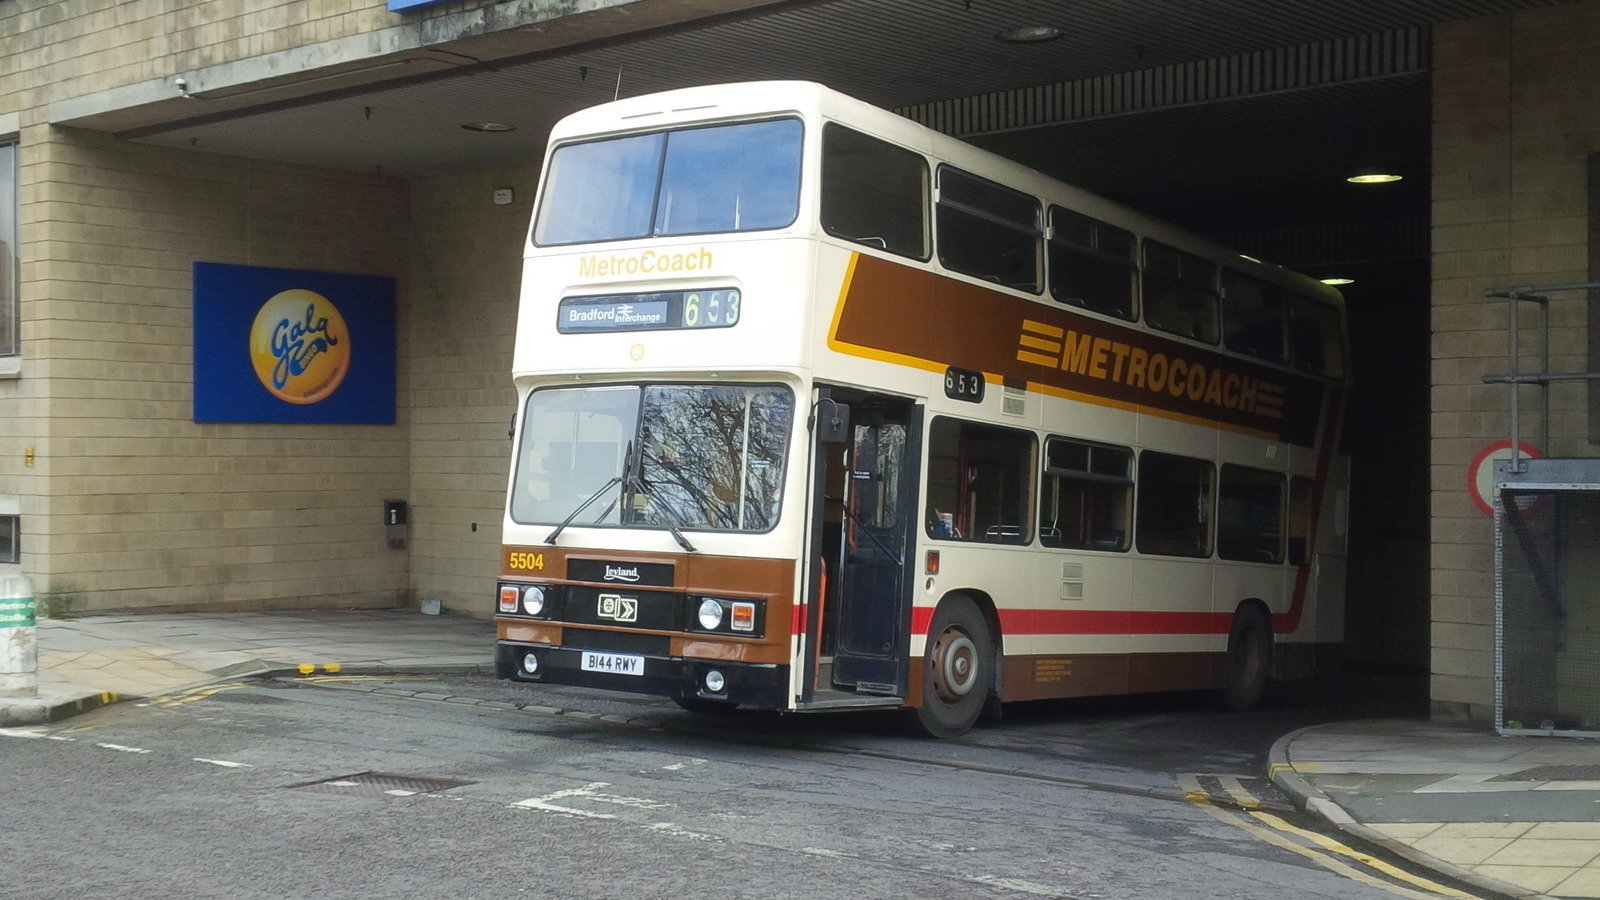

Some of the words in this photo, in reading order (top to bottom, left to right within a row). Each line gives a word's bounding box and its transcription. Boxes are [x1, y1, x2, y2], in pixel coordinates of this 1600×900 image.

[579, 247, 713, 278] MetroCoach
[569, 307, 615, 322] Bradford
[615, 313, 661, 323] Interchange
[684, 290, 741, 327] 653
[271, 303, 338, 390] Gala
[946, 371, 978, 395] 653
[1061, 330, 1258, 413] METROCOACH
[509, 552, 544, 570] 5504
[603, 565, 640, 581] Leyland
[588, 655, 612, 669] B144
[614, 657, 637, 671] RWY
